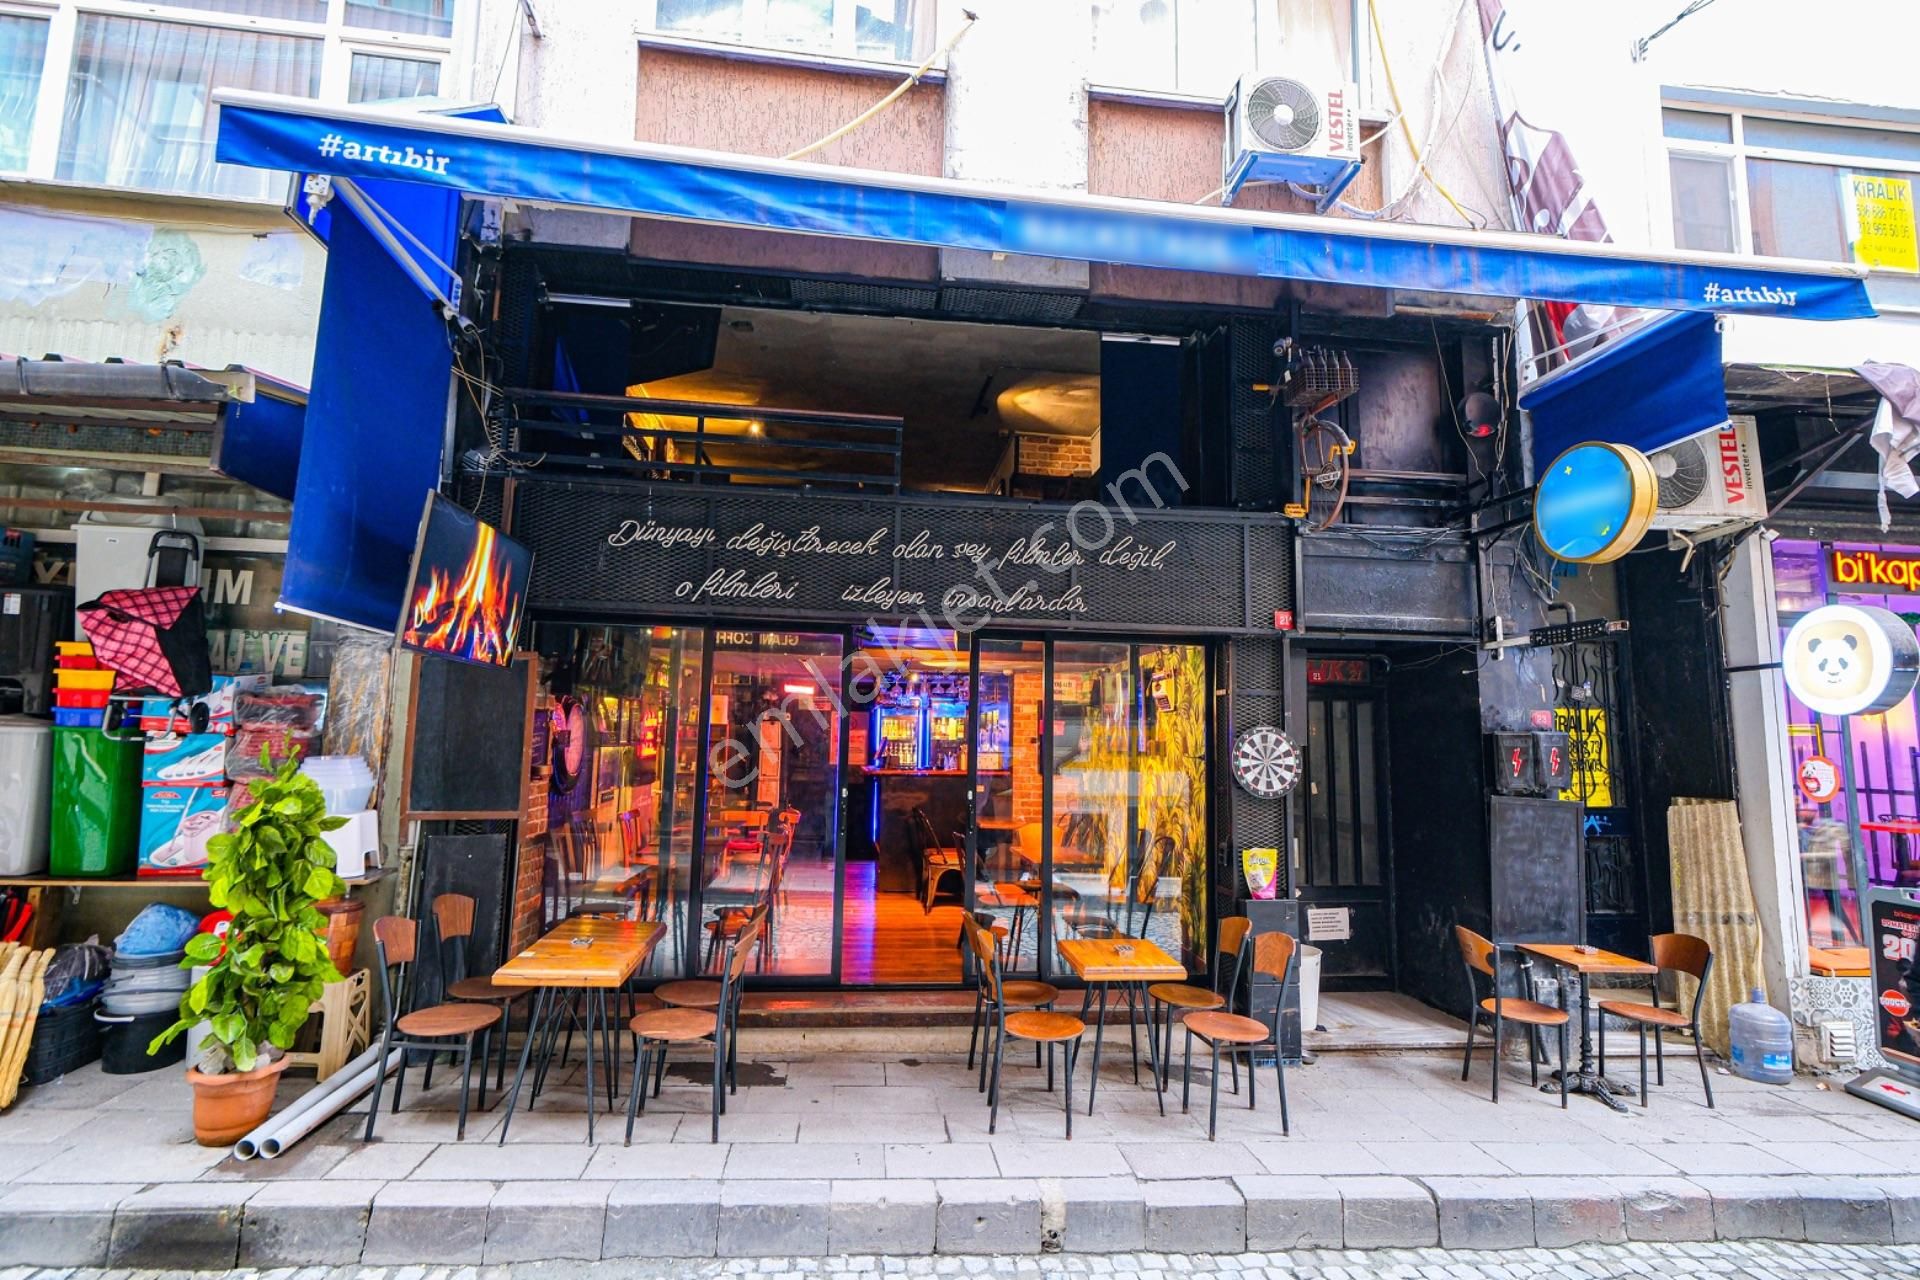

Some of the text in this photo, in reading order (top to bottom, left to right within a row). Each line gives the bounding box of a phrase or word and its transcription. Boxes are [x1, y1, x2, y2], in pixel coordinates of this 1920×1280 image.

[1328, 89, 1344, 151] VESTEL
[1718, 427, 1745, 503] VESTEL
[608, 520, 716, 548] Dünyayı
[726, 523, 888, 557] değiştirecek
[893, 530, 944, 559] olan
[998, 537, 1085, 570] filmler
[675, 581, 693, 597] o
[691, 568, 799, 601] filmleri
[841, 576, 925, 610] izleyen
[262, 632, 307, 676] VE
